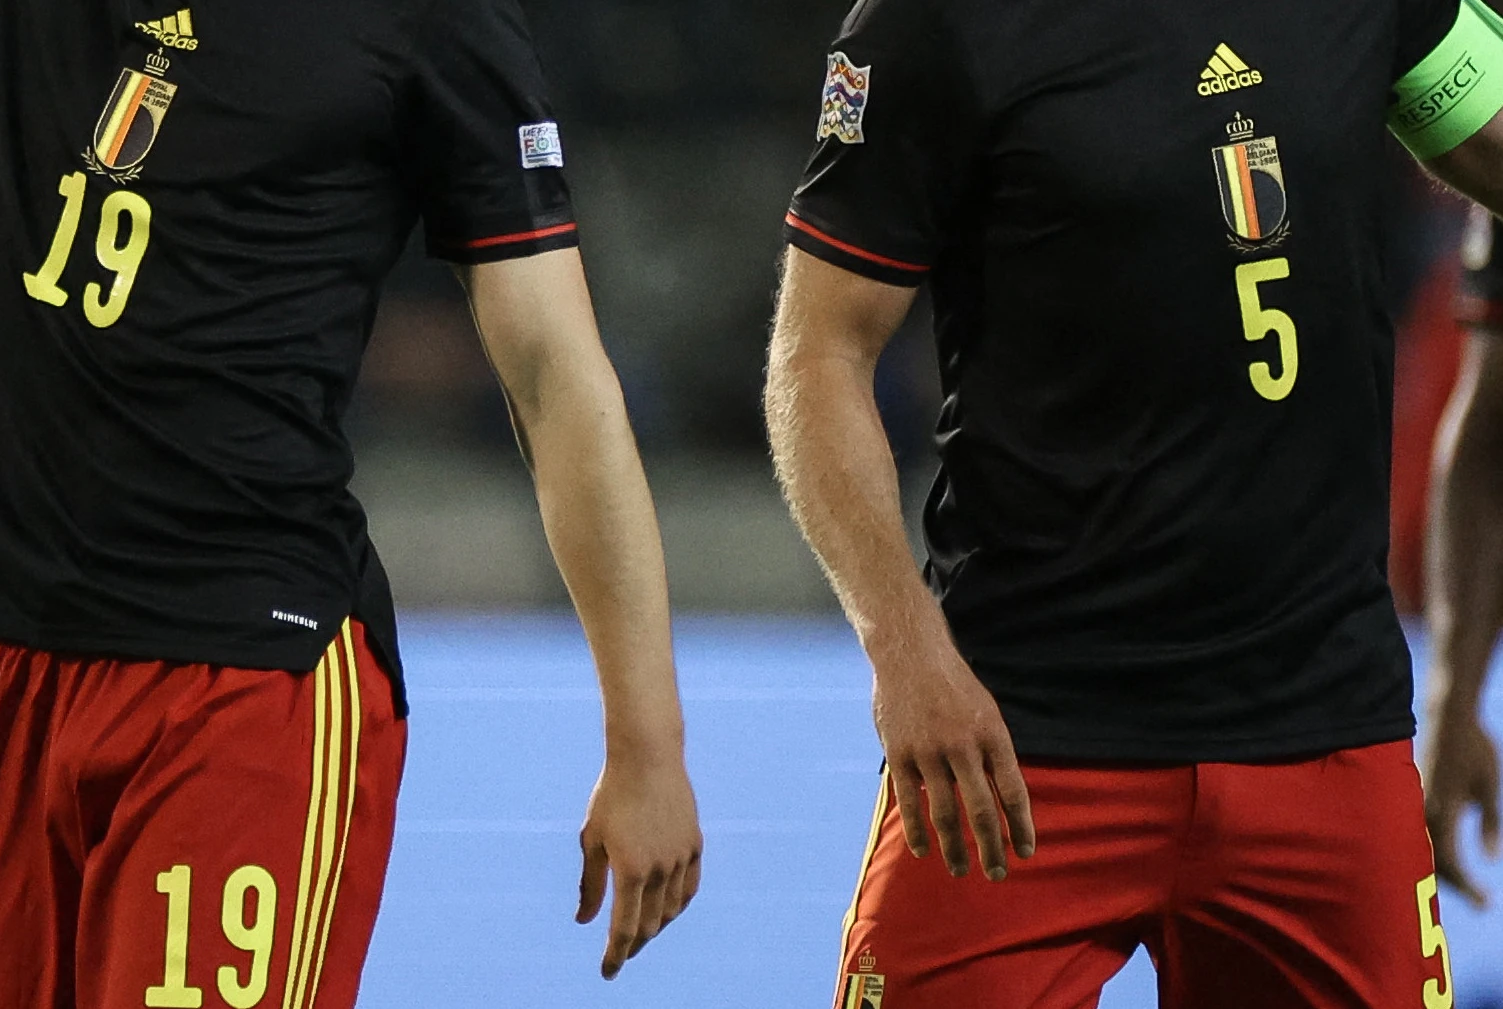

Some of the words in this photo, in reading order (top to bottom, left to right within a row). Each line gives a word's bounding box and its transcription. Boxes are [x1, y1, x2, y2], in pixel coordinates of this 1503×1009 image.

[1197, 70, 1263, 96] adidas
[1398, 56, 1478, 128] RESPECT
[23, 170, 152, 329] 19
[1235, 257, 1299, 402] 5
[145, 864, 278, 1009] 19
[1416, 873, 1454, 1009] 5
